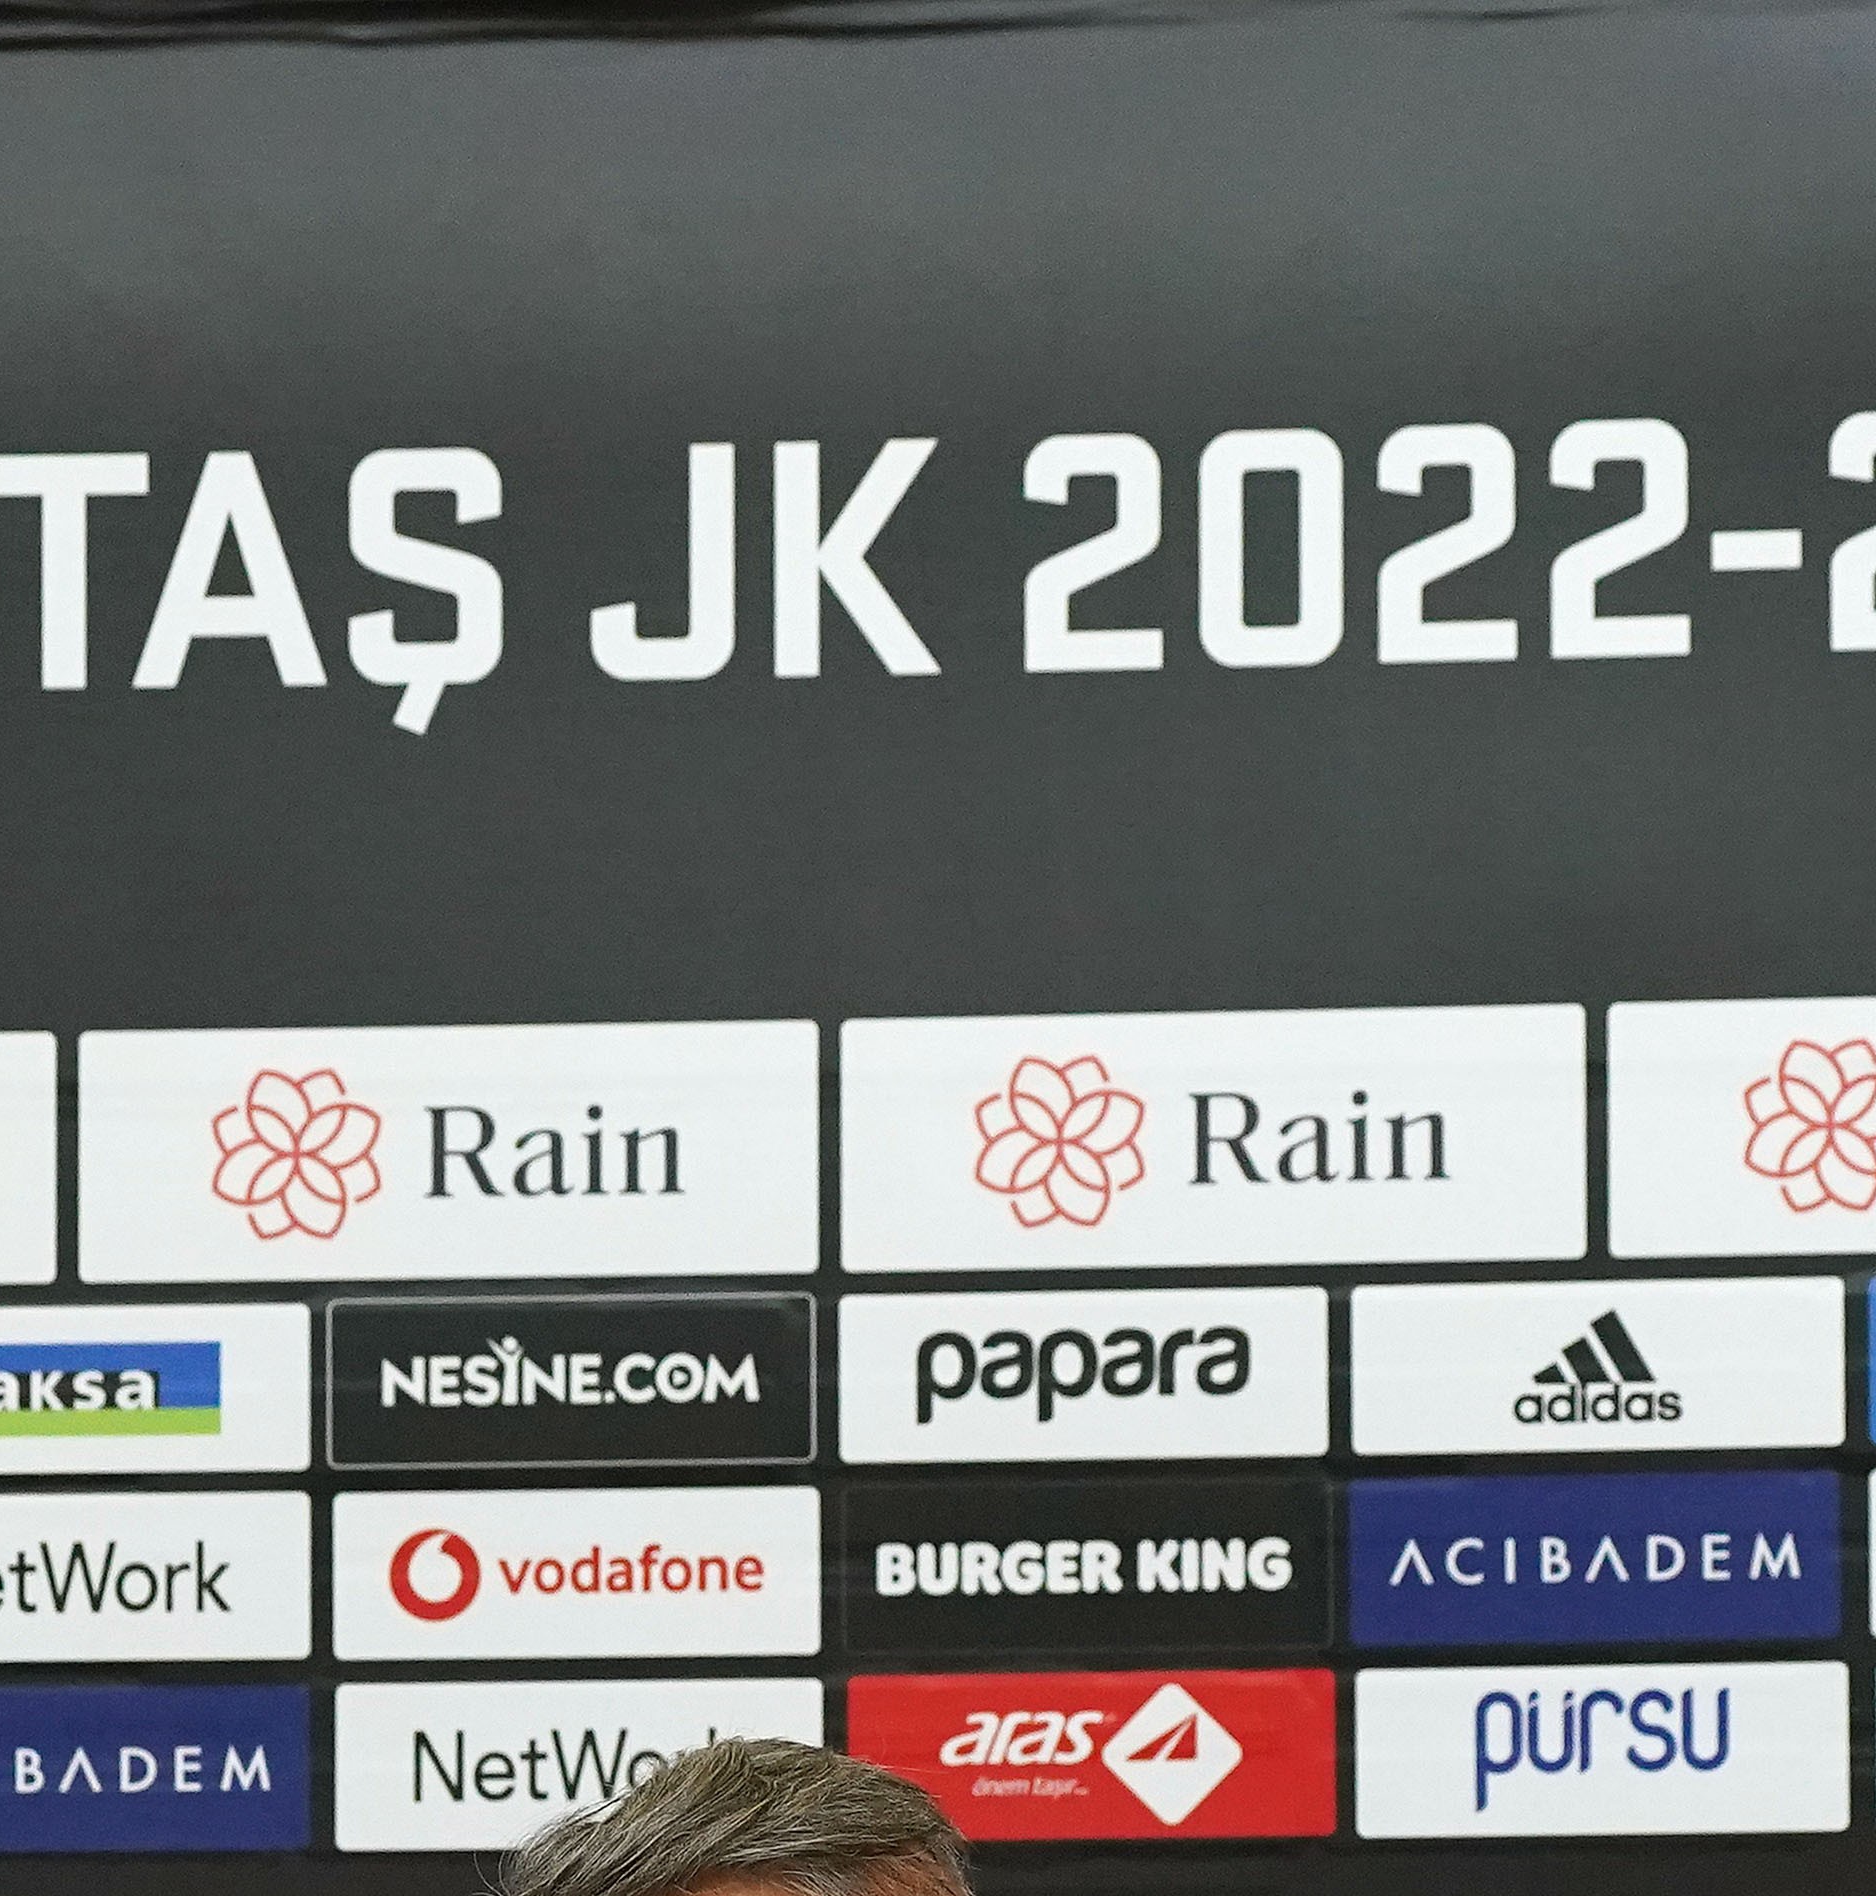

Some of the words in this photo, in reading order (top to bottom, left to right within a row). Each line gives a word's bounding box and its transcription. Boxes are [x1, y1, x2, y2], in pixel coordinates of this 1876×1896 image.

[590, 437, 941, 681] JK
[427, 1105, 682, 1198] Rain
[1190, 1090, 1449, 1185] Rain
[916, 1326, 1251, 1425] papara
[1513, 1379, 1682, 1424] adidas
[498, 1544, 764, 1595] vodafone
[875, 1540, 1124, 1597] BURGER
[1136, 1536, 1293, 1593] KING
[1389, 1533, 1801, 1586] ACIBADEM
[939, 1708, 1108, 1768] aras
